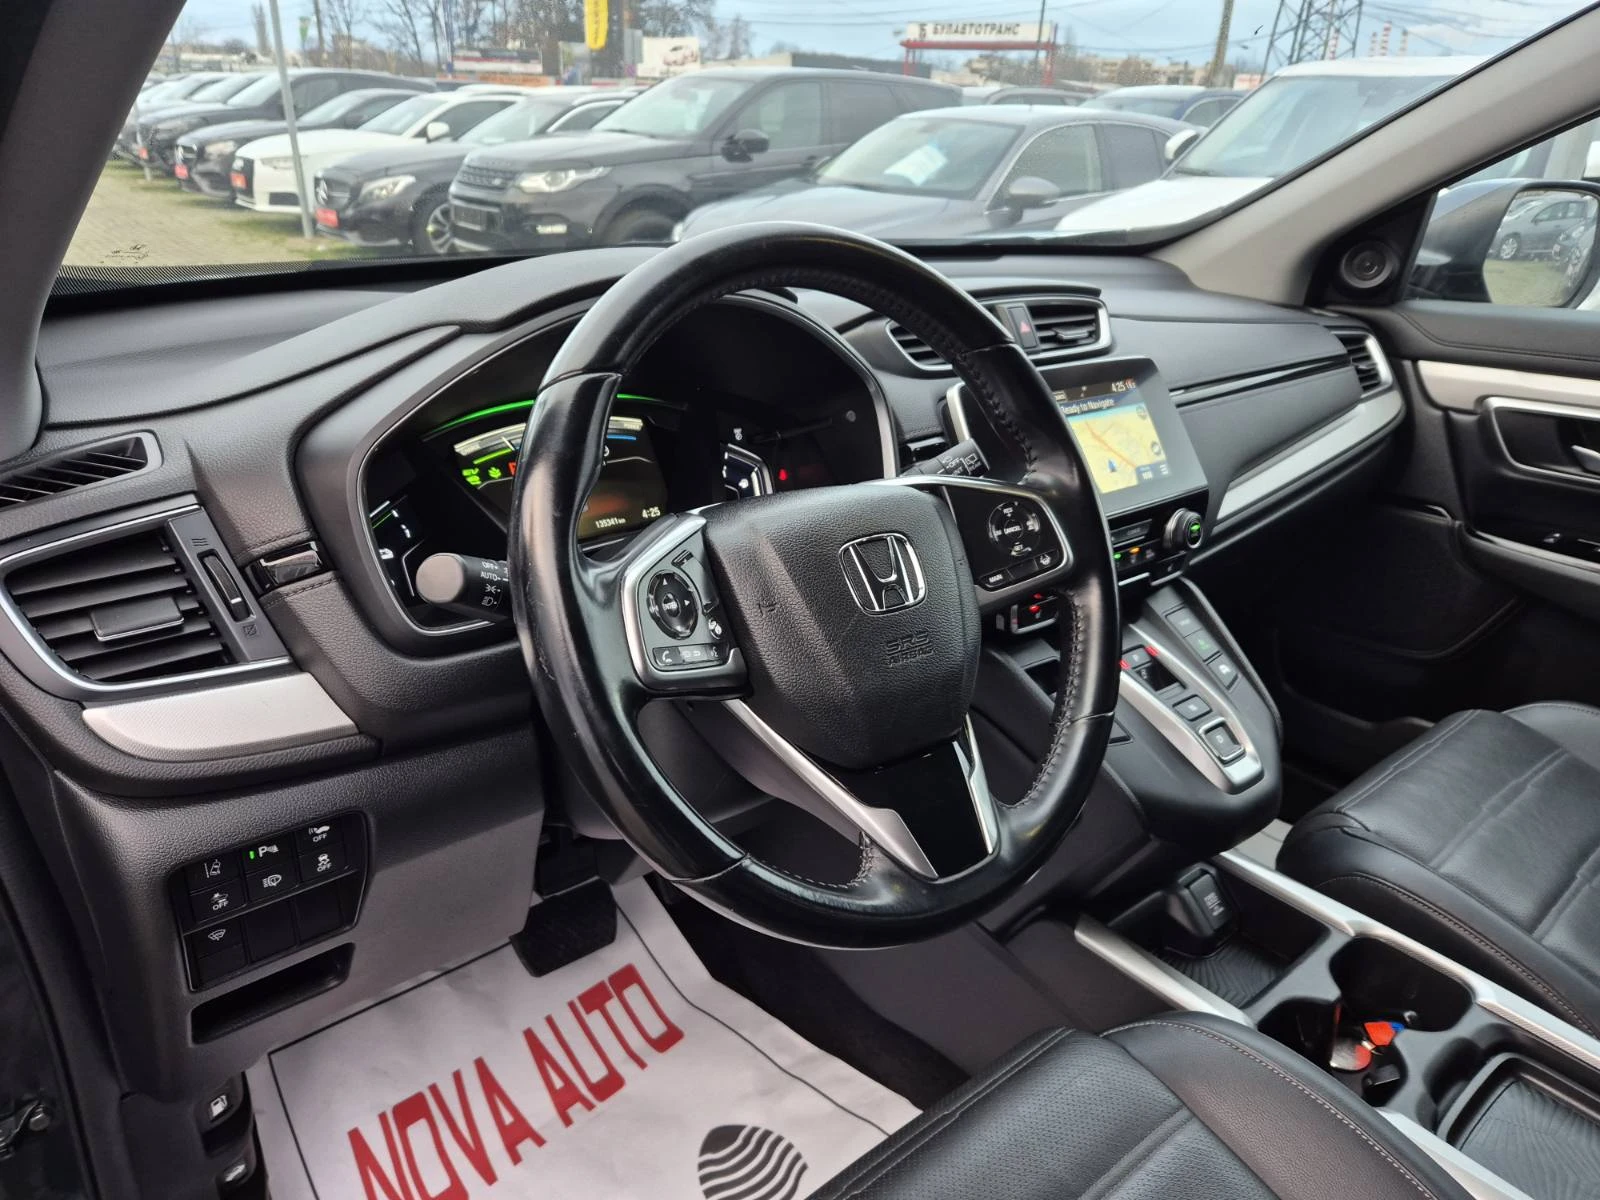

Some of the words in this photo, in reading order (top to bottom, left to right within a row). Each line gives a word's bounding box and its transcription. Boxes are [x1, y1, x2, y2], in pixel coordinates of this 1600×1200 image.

[642, 506, 661, 519] 4:25
[481, 561, 495, 570] OFF
[480, 571, 498, 581] AUTO
[886, 632, 930, 655] SRS
[313, 833, 328, 843] OFF
[317, 863, 332, 873] OFF
[212, 901, 229, 911] OFF
[347, 1056, 547, 1200] NOVA
[522, 962, 685, 1129] AUTO
